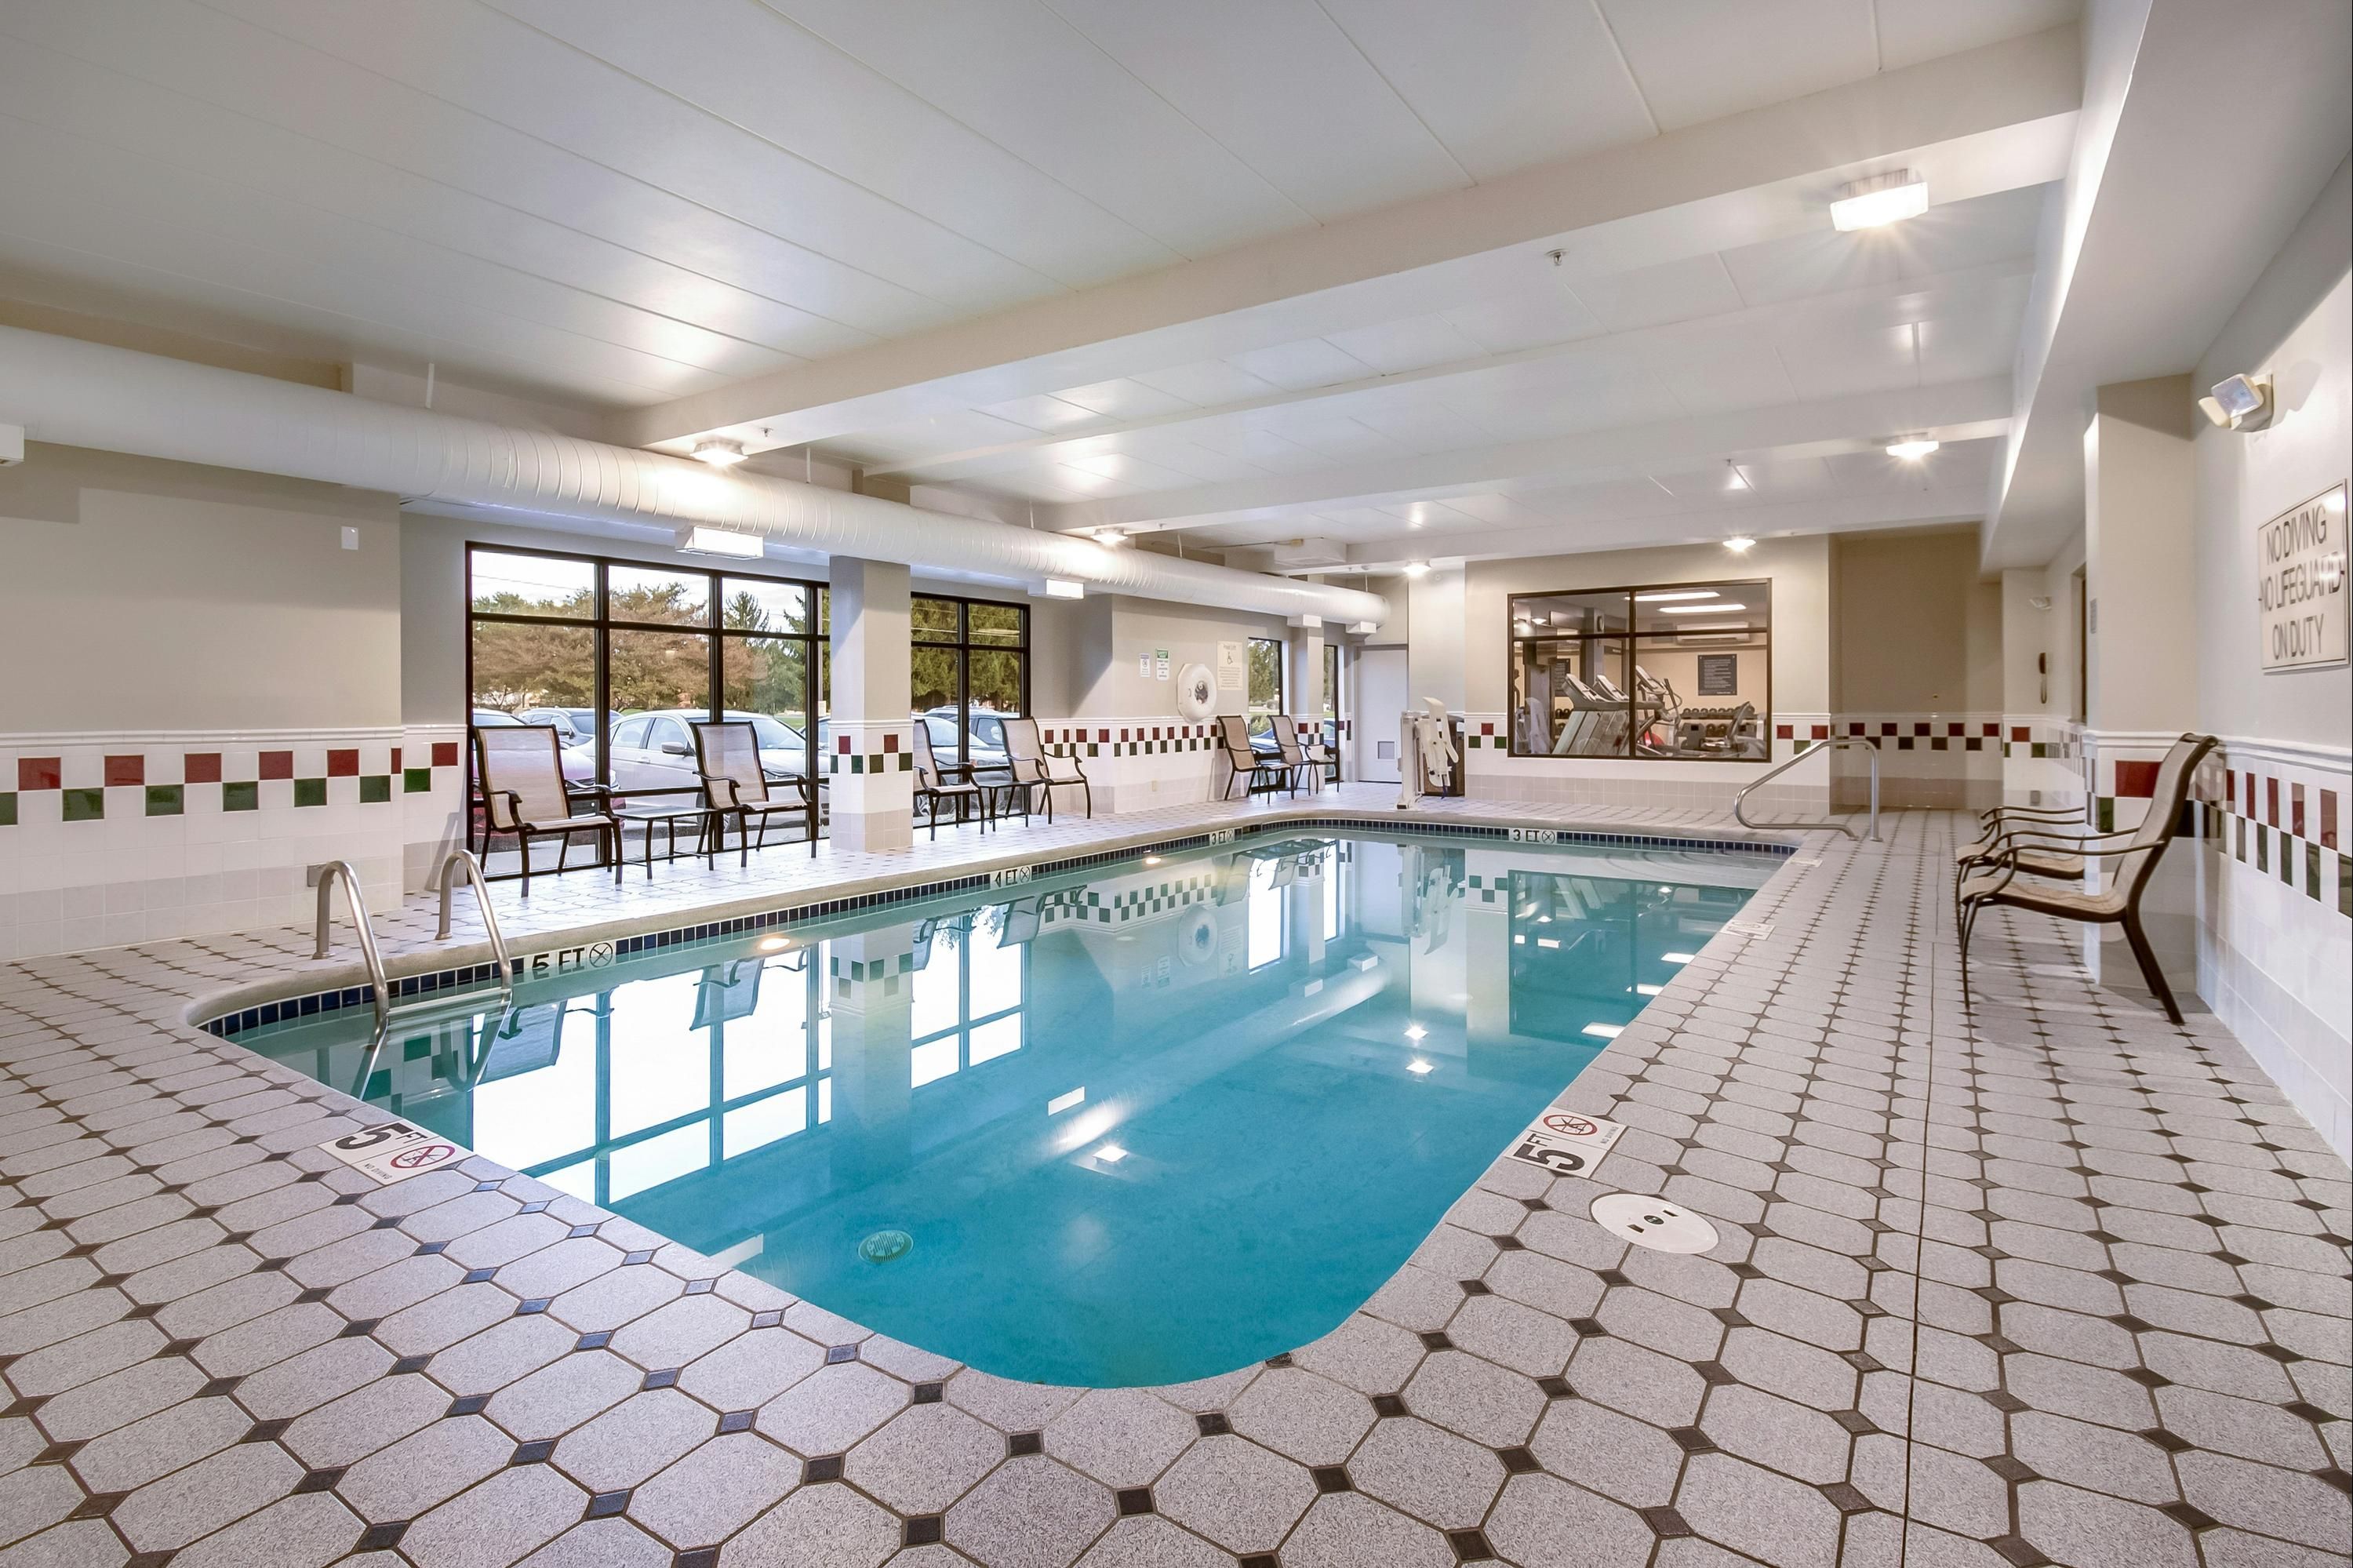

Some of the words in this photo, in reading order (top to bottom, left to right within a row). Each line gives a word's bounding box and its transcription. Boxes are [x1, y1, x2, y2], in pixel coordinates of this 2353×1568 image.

[2267, 525, 2282, 566] NO
[2283, 503, 2327, 558] DIVING
[2260, 575, 2273, 613] NO
[2272, 624, 2288, 660] ON
[2289, 613, 2325, 658] DUTY
[1212, 833, 1217, 845] 3
[1513, 828, 1521, 841] 3
[531, 953, 550, 973] 5
[558, 947, 585, 970] FT
[335, 1122, 414, 1150] 5
[395, 1132, 429, 1144] FT
[1526, 1133, 1553, 1147] FT
[1512, 1144, 1585, 1171] 5
